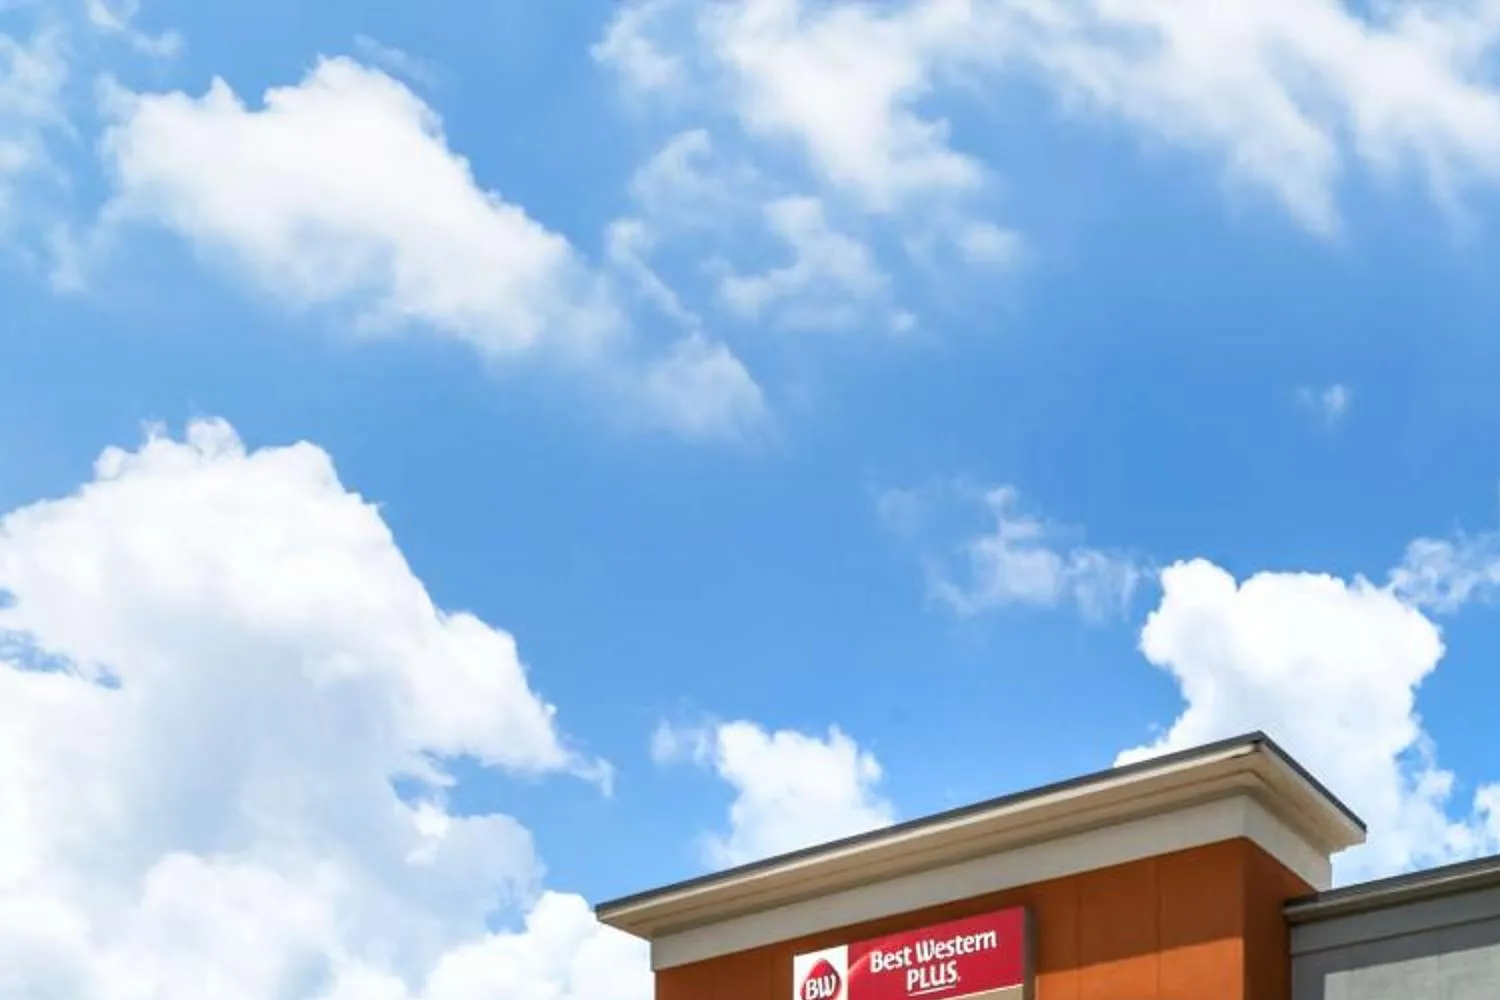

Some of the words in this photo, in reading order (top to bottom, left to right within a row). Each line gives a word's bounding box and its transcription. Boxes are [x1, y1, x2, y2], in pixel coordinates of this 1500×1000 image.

[870, 946, 912, 973] Best
[915, 930, 998, 963] Western
[804, 974, 837, 1000] BW
[906, 960, 958, 992] PLUS
